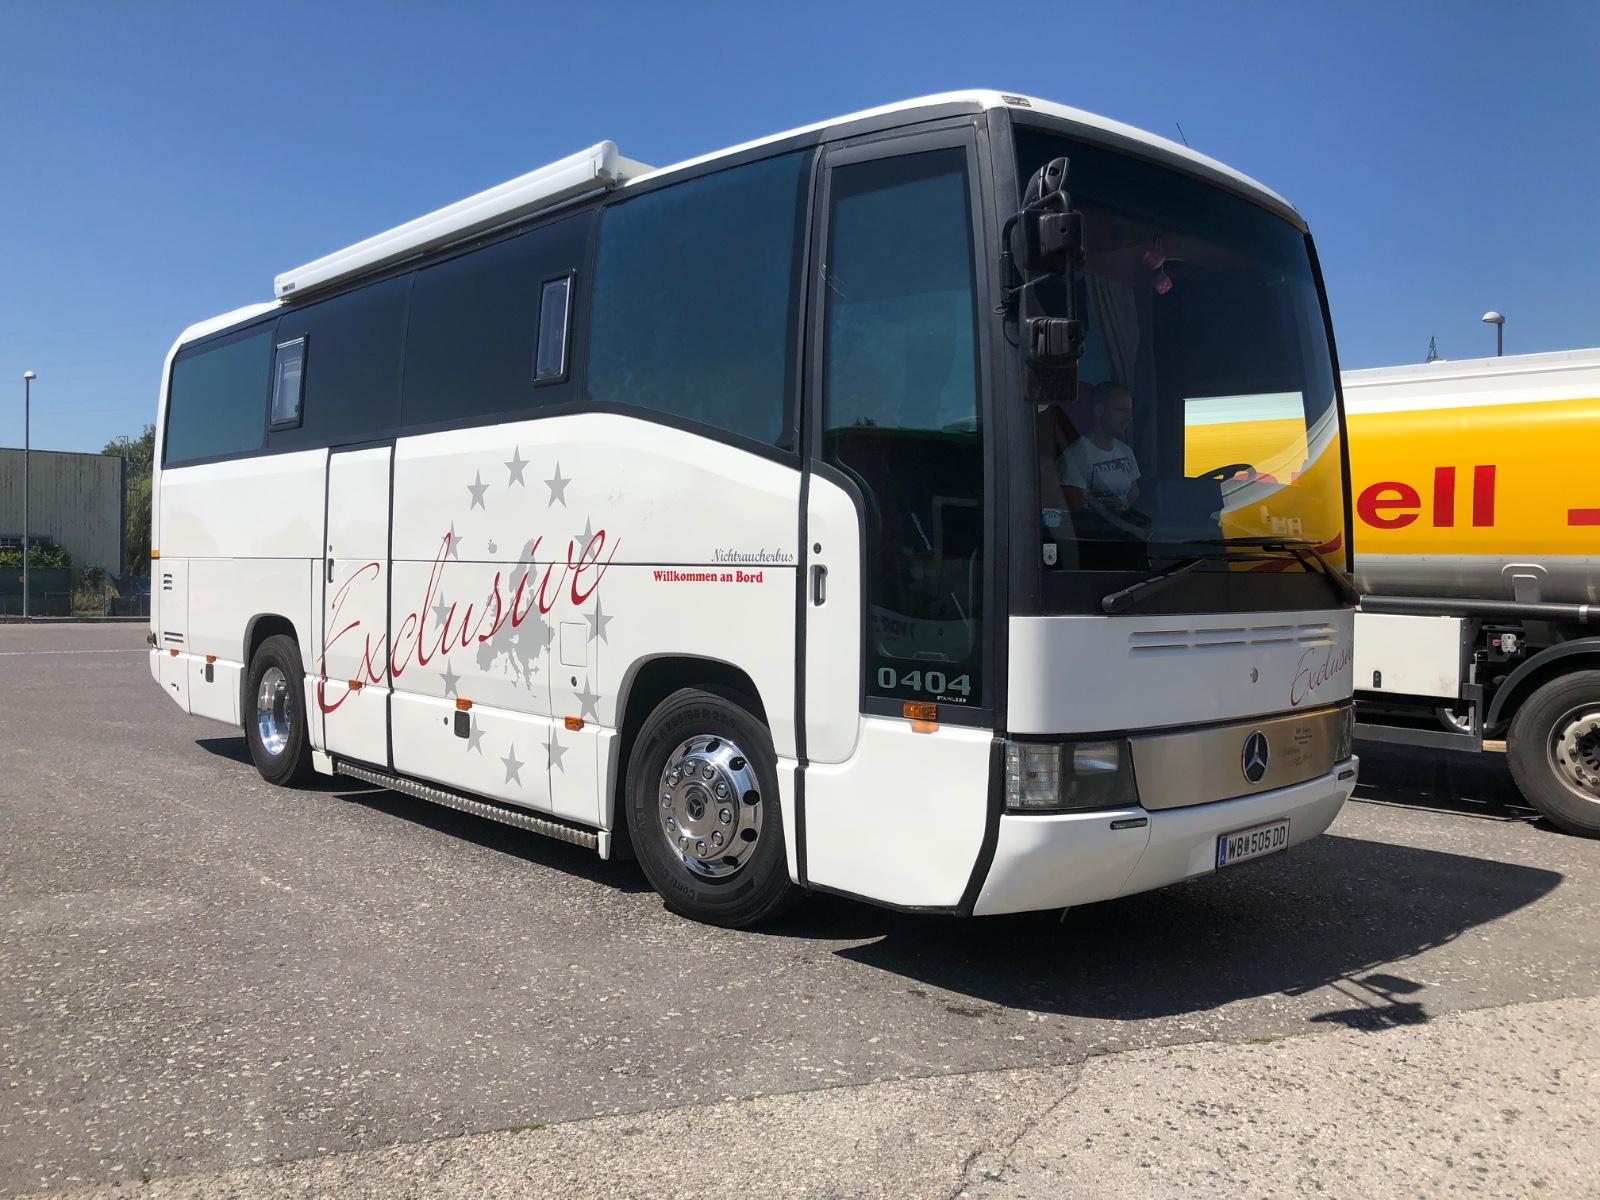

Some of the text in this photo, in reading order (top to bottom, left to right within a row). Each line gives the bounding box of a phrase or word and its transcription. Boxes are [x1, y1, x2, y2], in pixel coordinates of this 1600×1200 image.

[1356, 464, 1497, 530] ell
[711, 547, 795, 562] Nichtraucherbus
[652, 570, 764, 583] Willkommen an Bord
[316, 529, 622, 714] Exclusive
[1228, 825, 1287, 859] WB 505 DD
